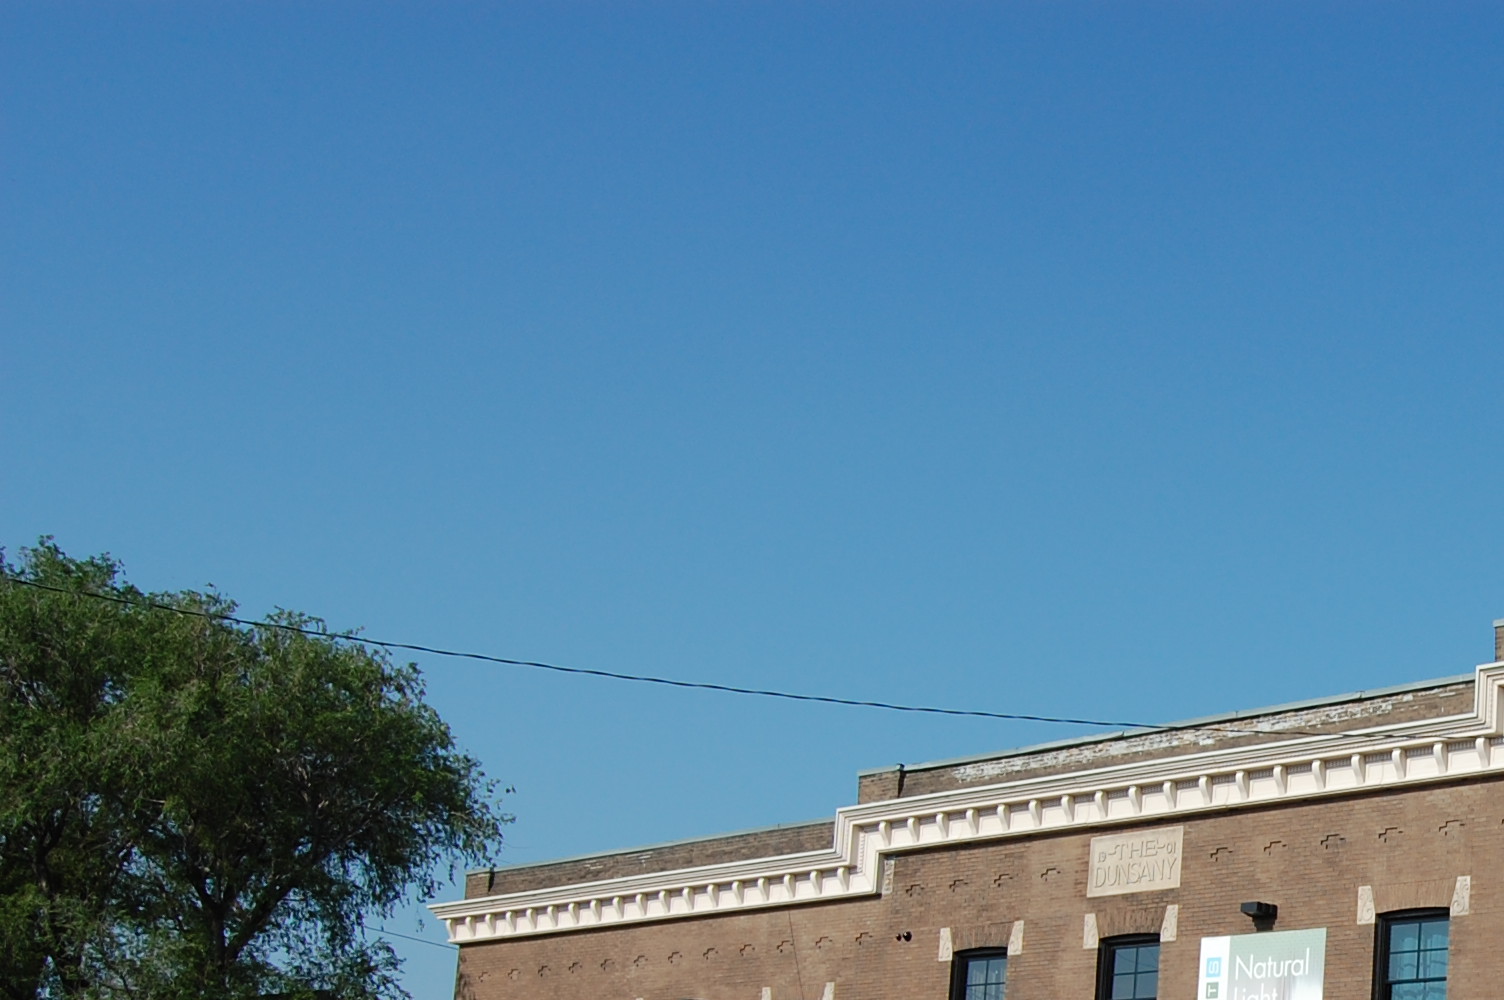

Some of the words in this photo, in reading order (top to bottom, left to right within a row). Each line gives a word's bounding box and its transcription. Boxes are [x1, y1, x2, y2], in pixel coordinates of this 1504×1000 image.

[1117, 840, 1158, 861] THE
[1095, 857, 1177, 888] DUNSANY
[1235, 947, 1310, 980] Natural
